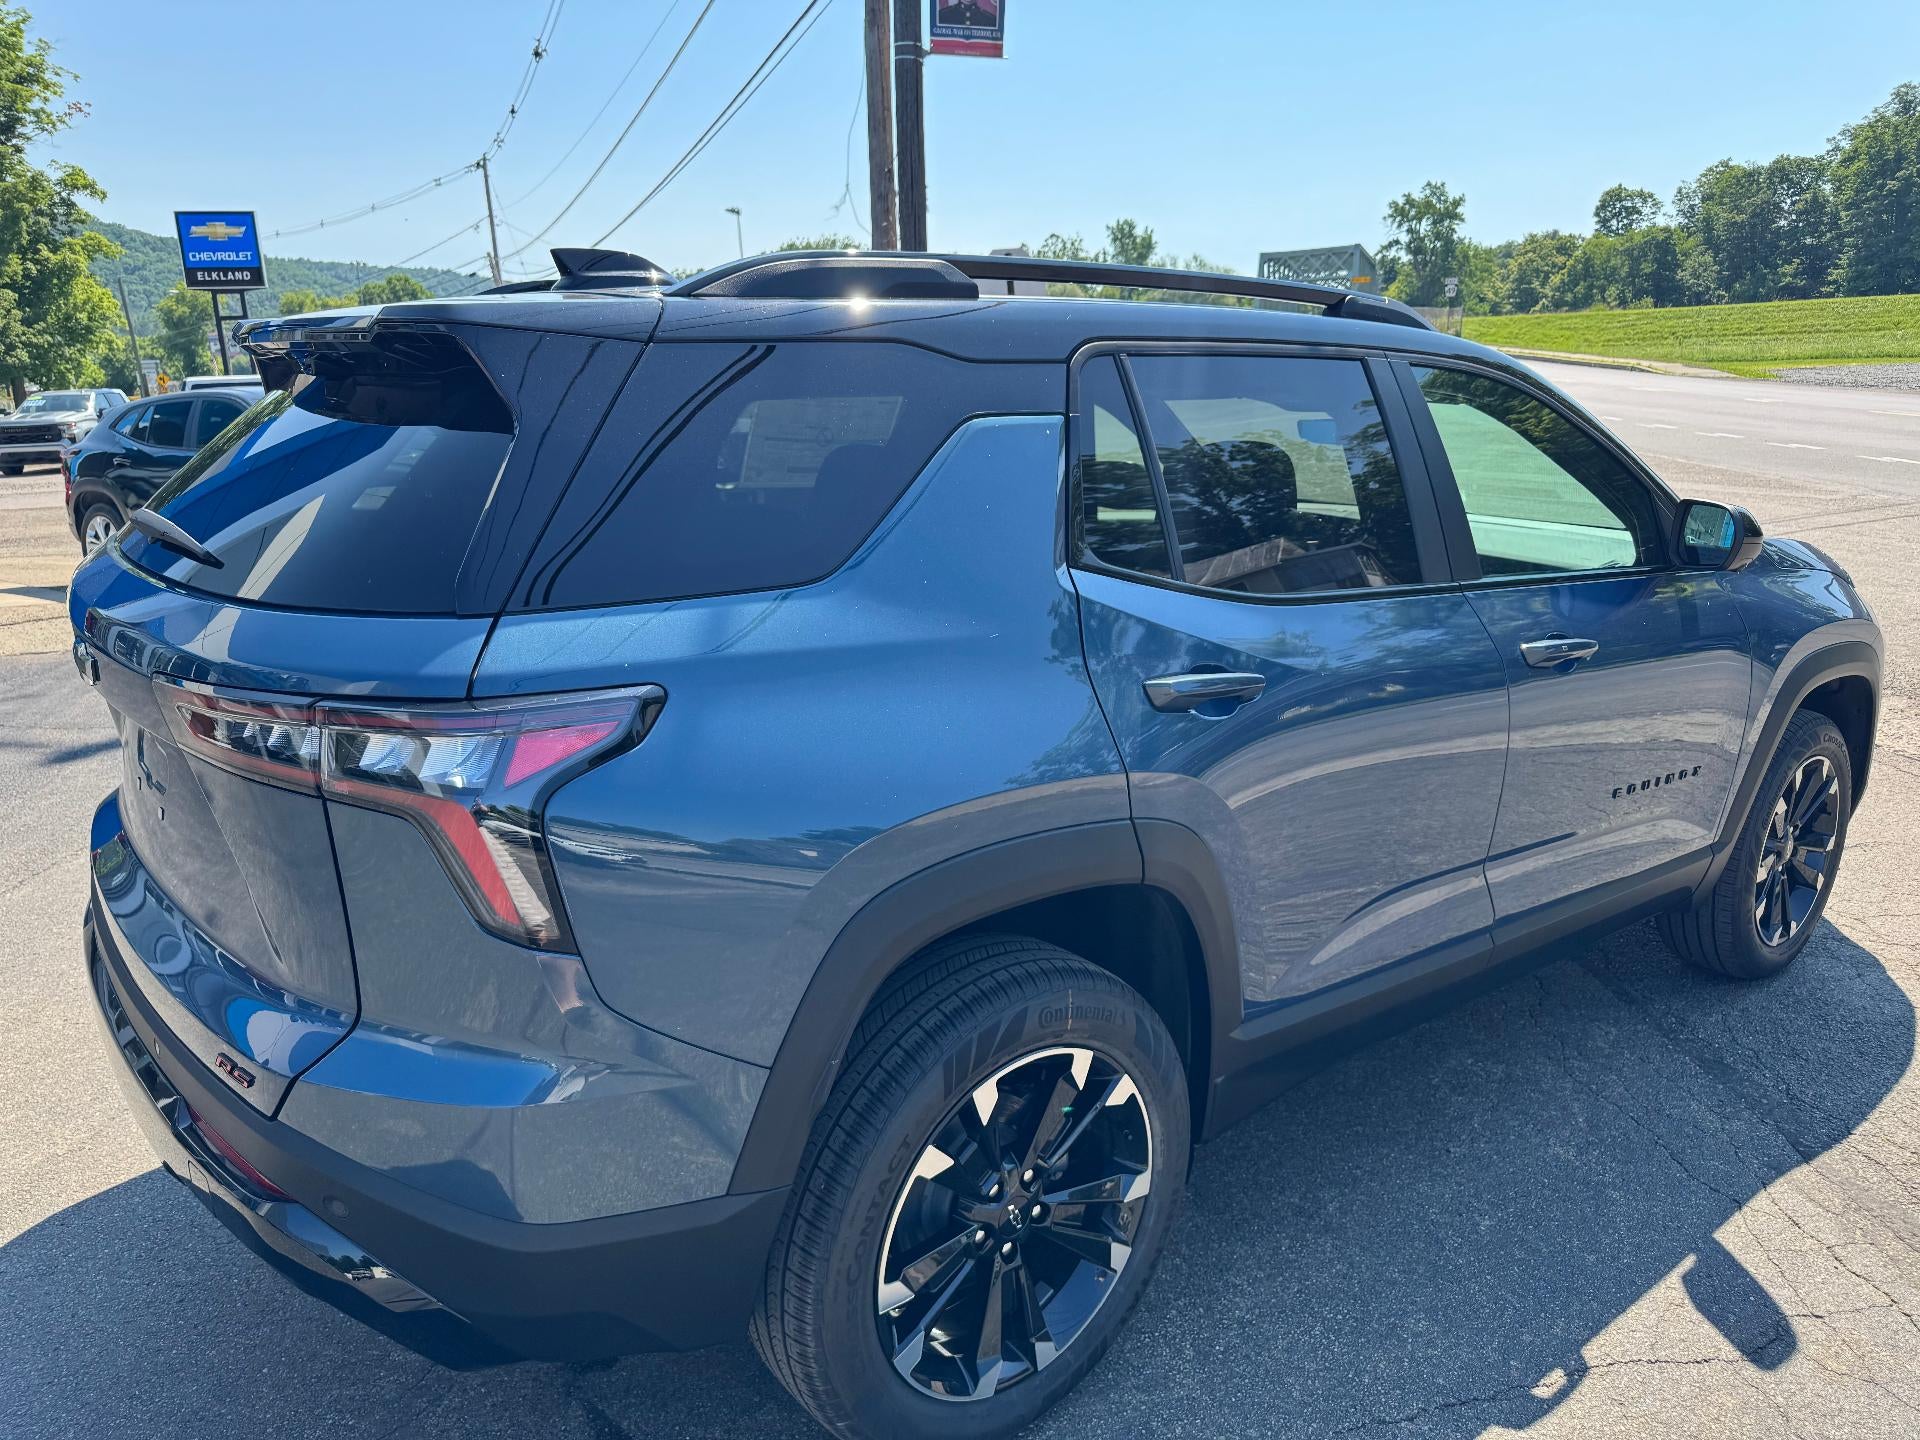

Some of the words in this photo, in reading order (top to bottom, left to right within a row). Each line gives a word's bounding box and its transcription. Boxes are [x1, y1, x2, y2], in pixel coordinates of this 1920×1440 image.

[188, 251, 253, 262] CHEVROLET
[196, 271, 251, 281] ELKLAND
[215, 1052, 257, 1089] RS
